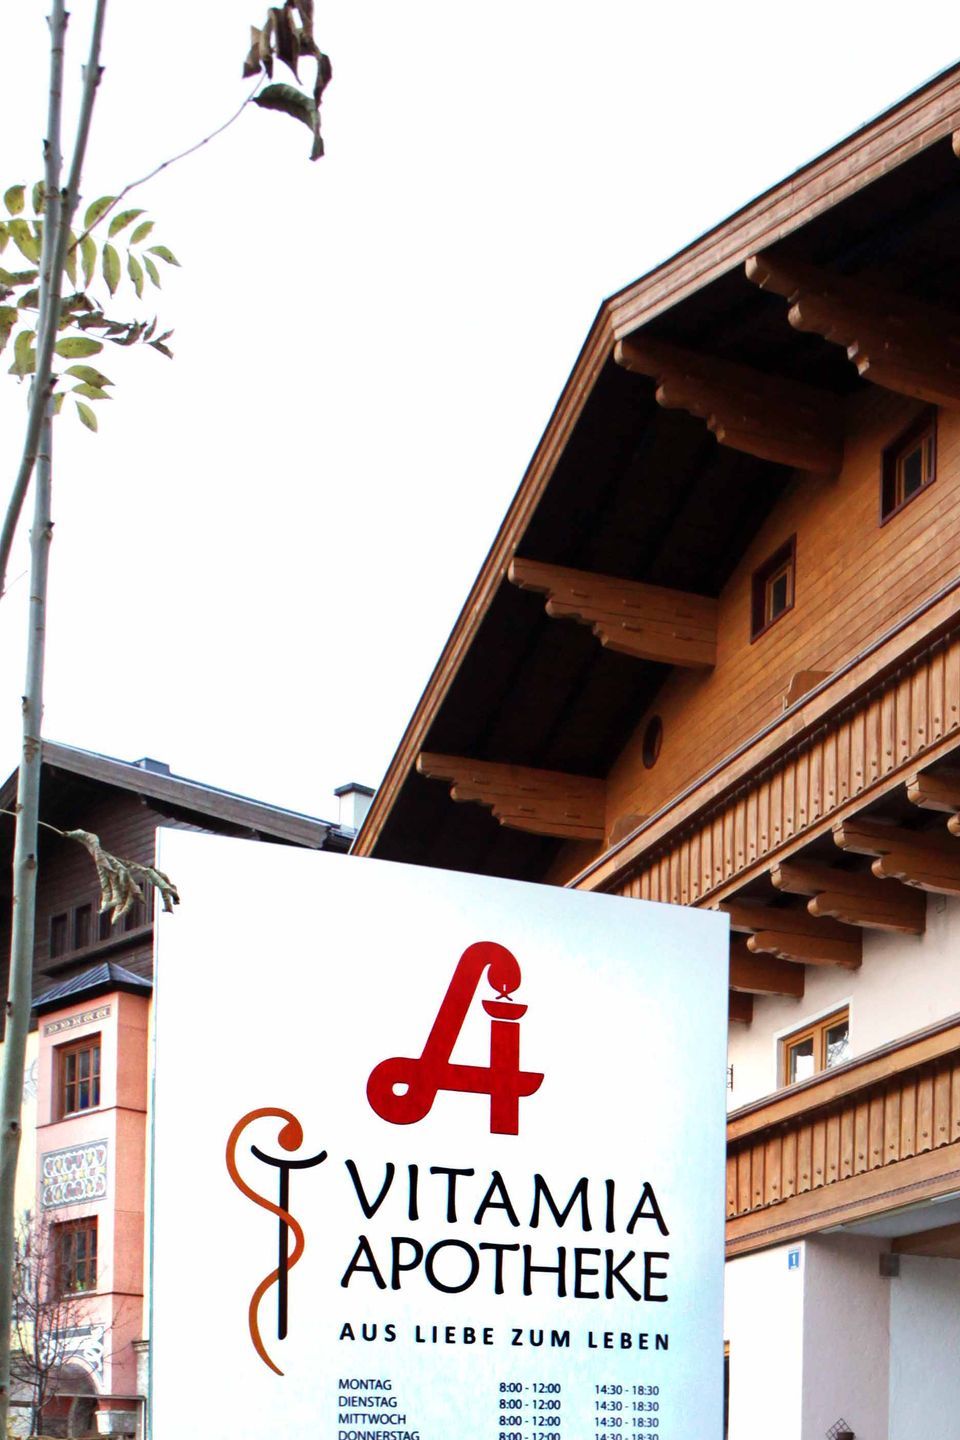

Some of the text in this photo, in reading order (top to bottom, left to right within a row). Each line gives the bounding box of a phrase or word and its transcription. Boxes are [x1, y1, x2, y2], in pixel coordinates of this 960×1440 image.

[345, 1159, 670, 1236] VITAMIA
[341, 1235, 670, 1302] APOTHEKE
[339, 1322, 669, 1350] AUS LIEBE ZUM LEBEN
[338, 1379, 392, 1391] MONTAG
[499, 1382, 523, 1393] 8:00
[532, 1382, 561, 1393] 12:00
[595, 1384, 623, 1395] 14:30
[632, 1384, 660, 1395] 18:30
[338, 1396, 398, 1408] DIENSTAG
[499, 1398, 523, 1409] 8:00
[532, 1398, 561, 1409] 12:00
[595, 1400, 623, 1411] 14:30
[632, 1400, 660, 1411] 18:30
[338, 1413, 407, 1425] MITTWOCH
[499, 1415, 523, 1426] 8:00
[532, 1415, 561, 1426] 12:00
[595, 1416, 623, 1427] 14:30
[632, 1416, 660, 1427] 18:30
